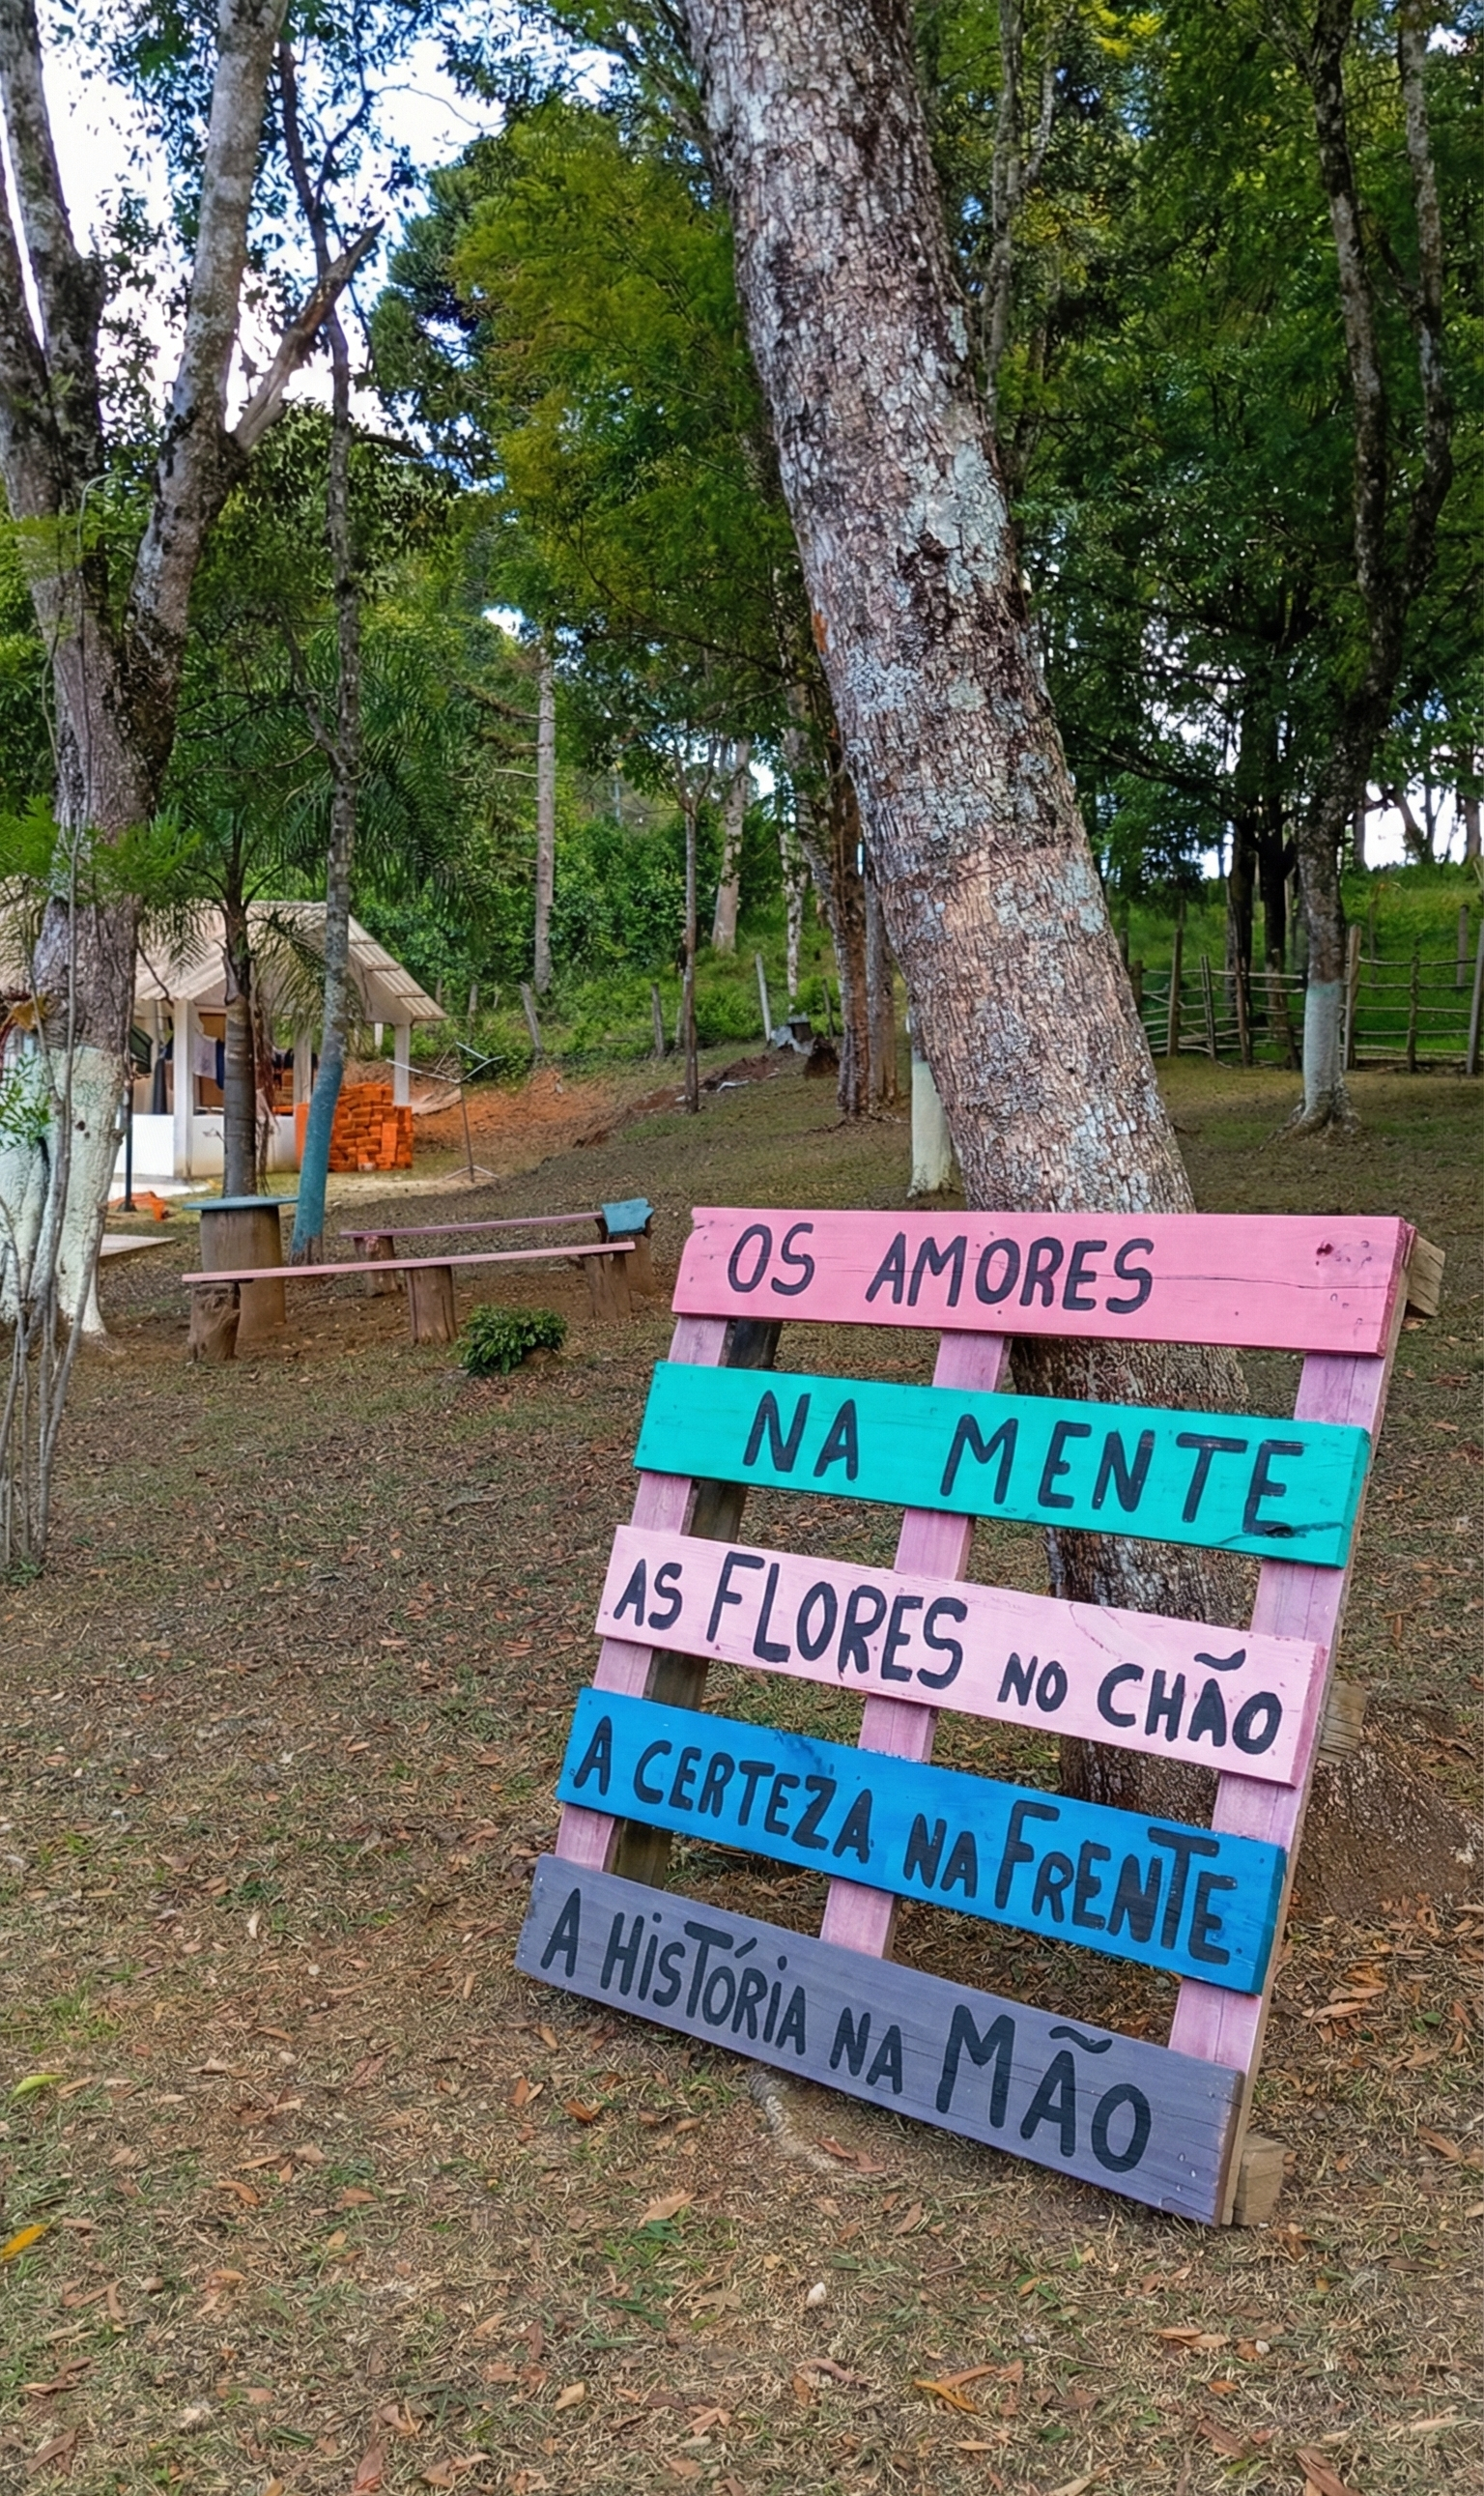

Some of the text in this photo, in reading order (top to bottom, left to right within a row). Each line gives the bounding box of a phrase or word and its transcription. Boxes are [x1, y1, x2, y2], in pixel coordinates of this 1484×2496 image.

[727, 1223, 1155, 1314] OS AMORES
[744, 1391, 1304, 1536] NA MENTE
[614, 1553, 1281, 1755] AS FLORES NO CHÃO
[573, 1716, 1237, 1965] A CERTEZA NA FRENTE
[541, 1888, 582, 1978] A
[831, 2008, 902, 2095] NA
[936, 2005, 1151, 2173] MÃO
